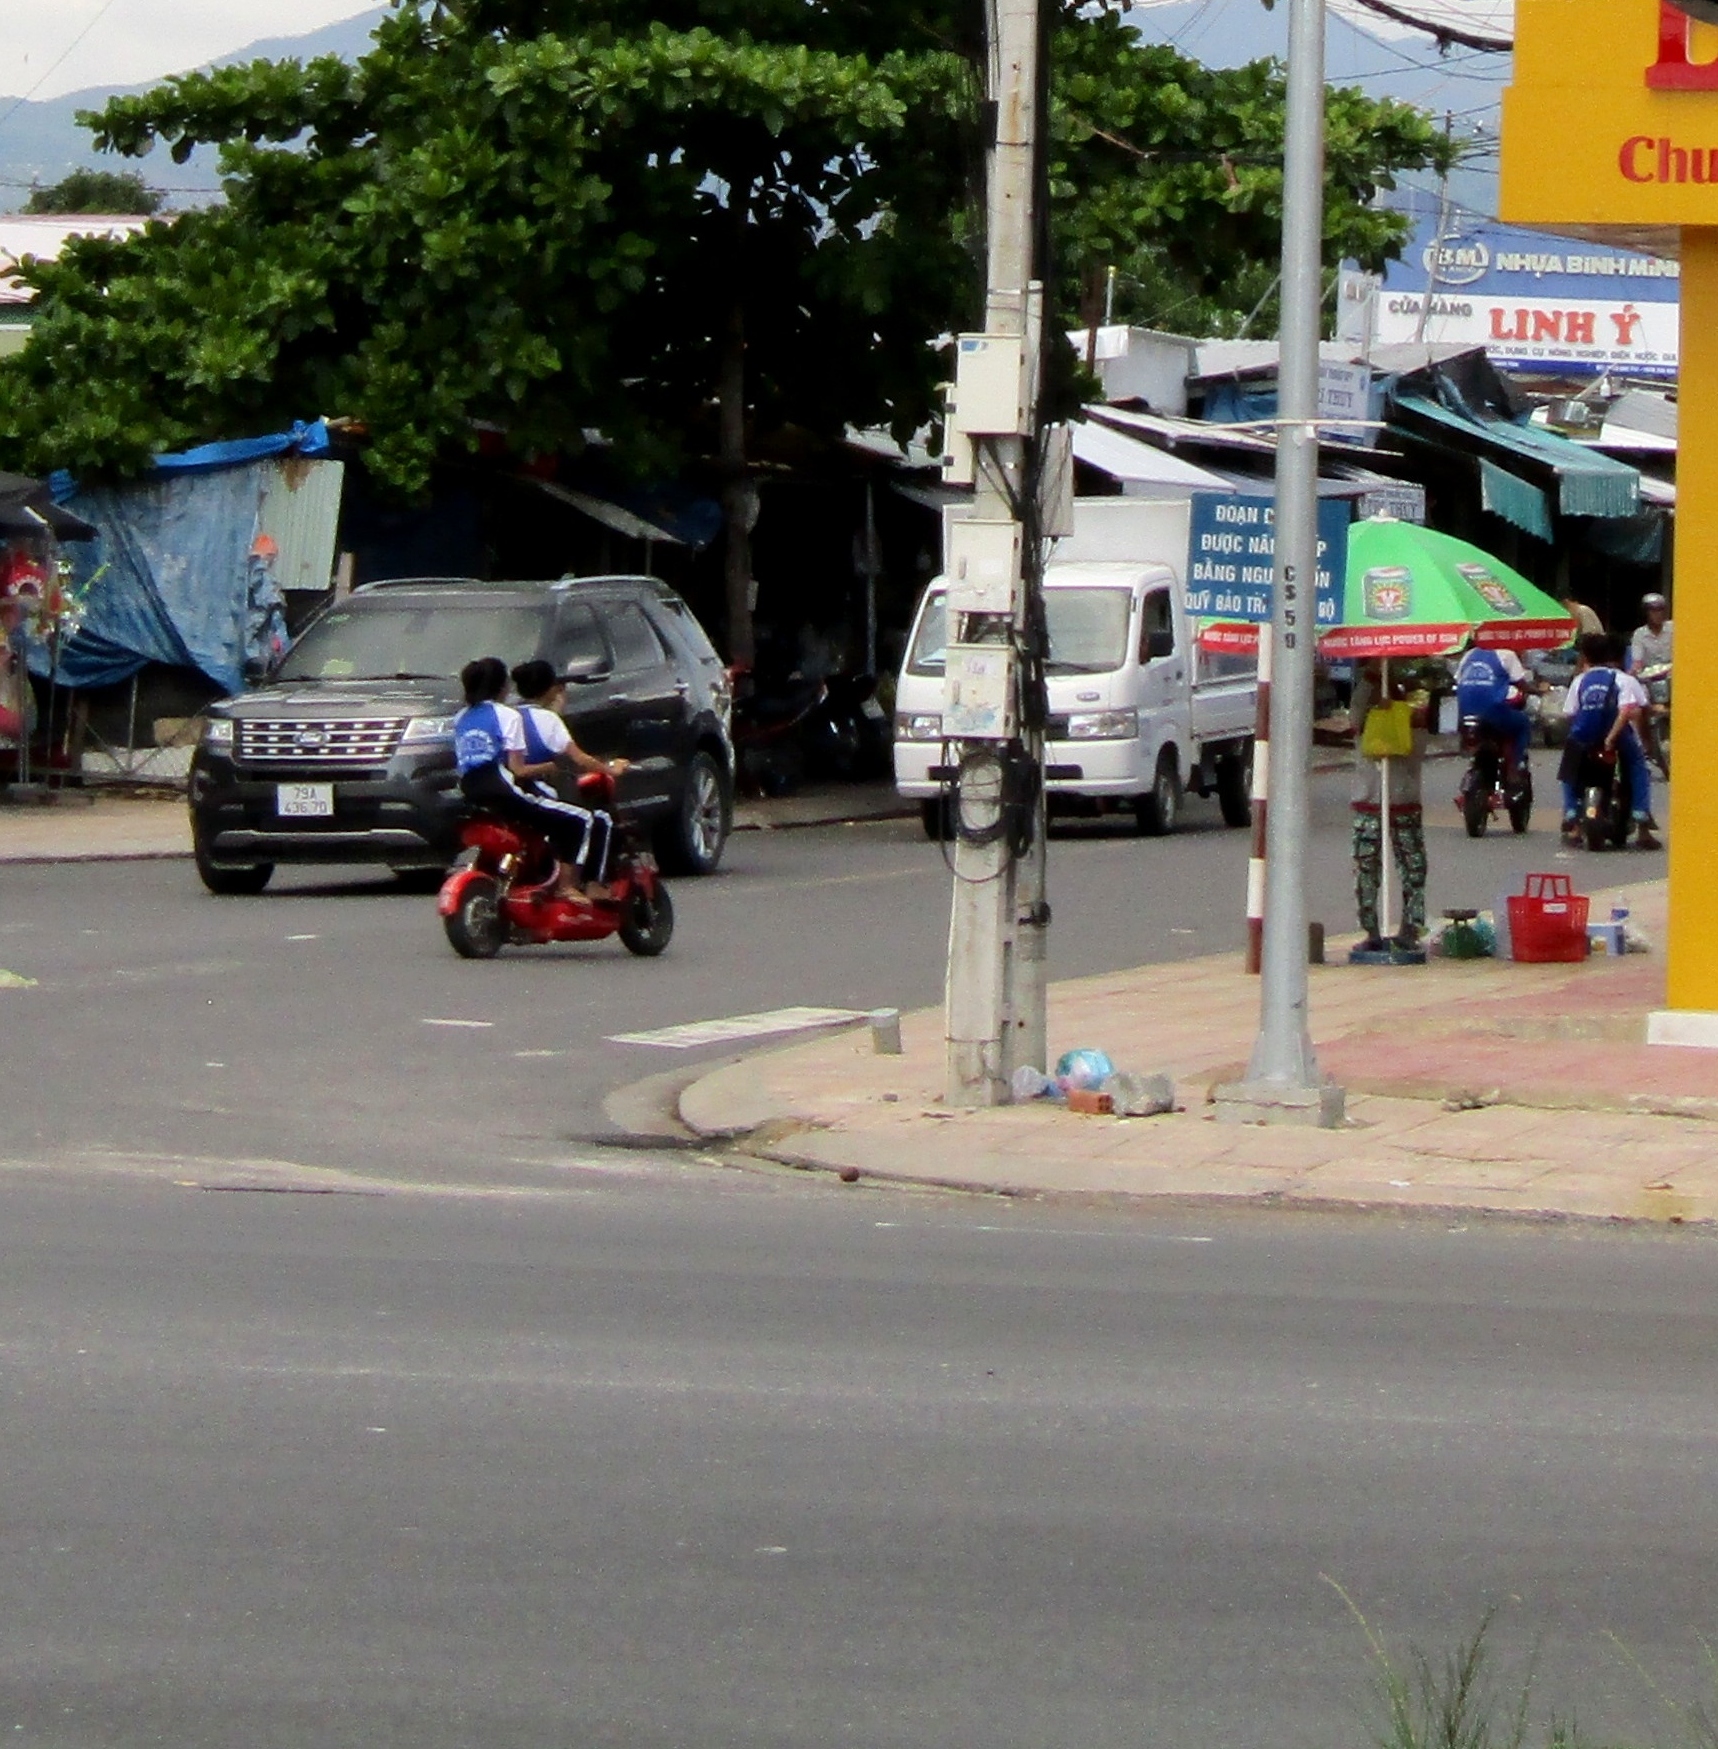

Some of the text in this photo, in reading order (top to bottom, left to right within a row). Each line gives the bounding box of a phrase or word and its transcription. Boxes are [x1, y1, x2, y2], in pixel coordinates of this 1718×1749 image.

[1496, 252, 1563, 278] NHỰA
[1489, 304, 1640, 345] LINH Ý
[1216, 505, 1258, 526] ĐOẠN
[1201, 533, 1243, 554] ĐƯỢC
[1194, 557, 1235, 581] BẰNG
[1184, 590, 1210, 609] QUỸ
[1215, 590, 1242, 612] BẢO
[1318, 597, 1336, 621] BỘ
[1392, 633, 1426, 646] POWER
[1428, 633, 1440, 645] OF
